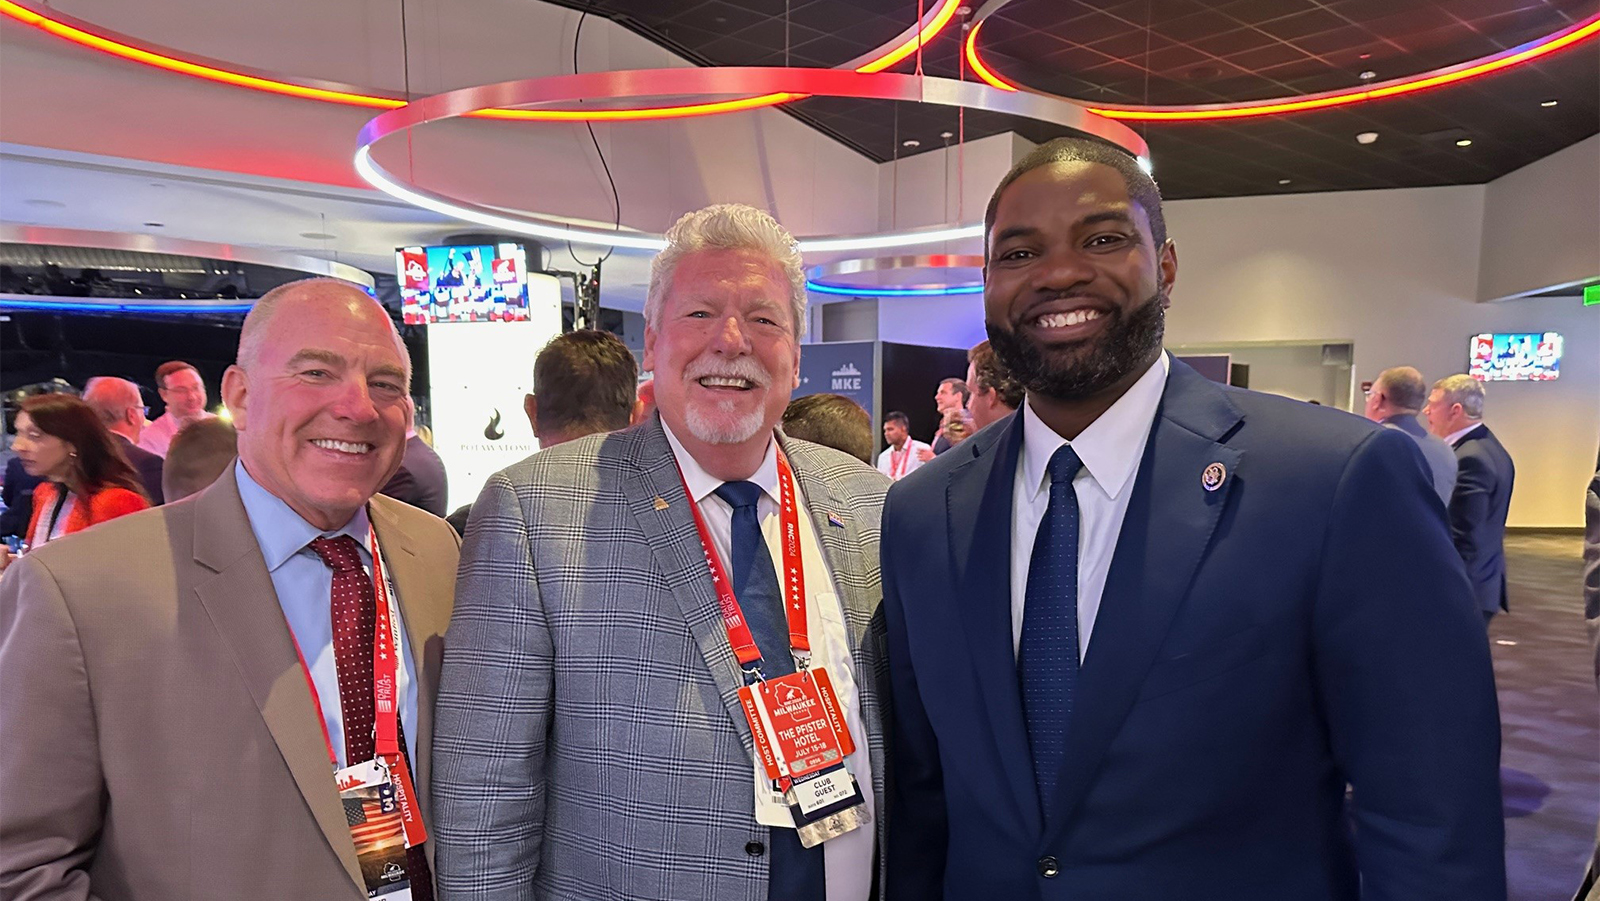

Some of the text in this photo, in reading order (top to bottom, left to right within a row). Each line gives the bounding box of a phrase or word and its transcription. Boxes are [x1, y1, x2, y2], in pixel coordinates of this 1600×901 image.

[832, 378, 861, 390] MKE
[787, 522, 796, 557] RNC2024
[722, 593, 737, 616] TRUST
[377, 678, 387, 700] DATA
[383, 673, 392, 700] TRUST
[773, 698, 817, 717] MILWAUKEE
[820, 686, 843, 733] HOSPITALITY
[746, 699, 774, 766] HOST COMMITTEE
[778, 719, 828, 741] THE PFISTER
[793, 732, 821, 748] HOTEL
[795, 741, 827, 758] JULY 15-18
[813, 777, 832, 789] CLUB
[814, 784, 836, 798] GUEST
[838, 789, 848, 797] 072
[393, 773, 413, 822] HOSPITALITY
